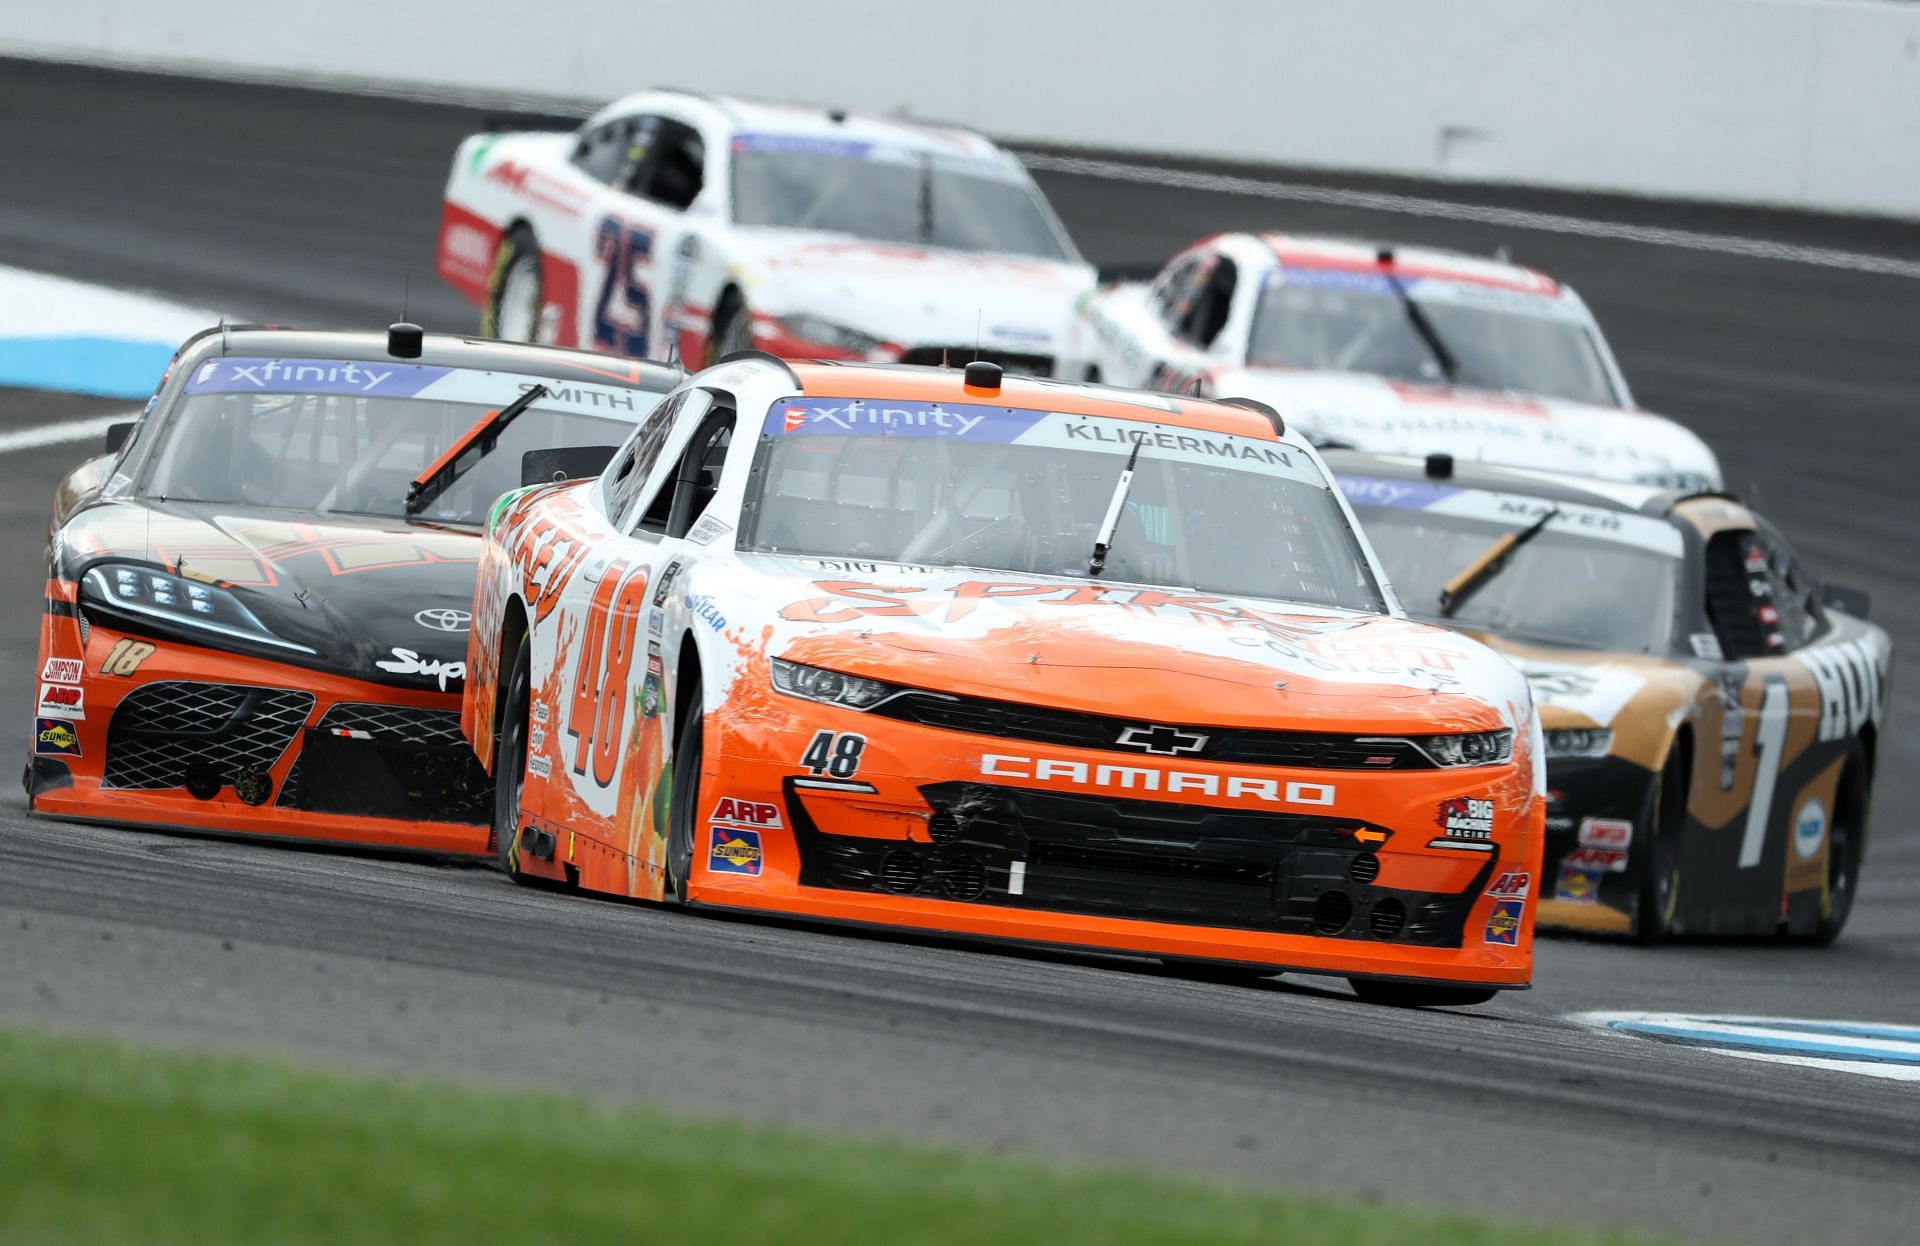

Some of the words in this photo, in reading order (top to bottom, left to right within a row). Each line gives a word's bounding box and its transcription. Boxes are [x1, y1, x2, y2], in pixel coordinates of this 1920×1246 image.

[593, 212, 657, 358] 25
[230, 361, 393, 391] xfinity
[517, 383, 634, 411] SMITH
[808, 400, 986, 435] xfinity
[1065, 423, 1293, 469] KLIGERMAN
[1339, 479, 1414, 505] nity
[1498, 499, 1622, 532] MAYER
[44, 660, 82, 681] SIMPSON
[100, 637, 157, 678] 18
[376, 647, 467, 692] Sup
[567, 556, 652, 789] 48
[42, 686, 81, 706] ARP
[41, 731, 76, 743] SUNOCO
[800, 730, 867, 779] 48
[980, 752, 1336, 806] CAMARO
[1738, 673, 1787, 869] 1
[713, 798, 778, 824] ARP
[1446, 817, 1493, 831] MACHINE
[1467, 799, 1493, 819] BIG
[1446, 828, 1492, 839] RACING
[713, 845, 761, 861] SUNOCO
